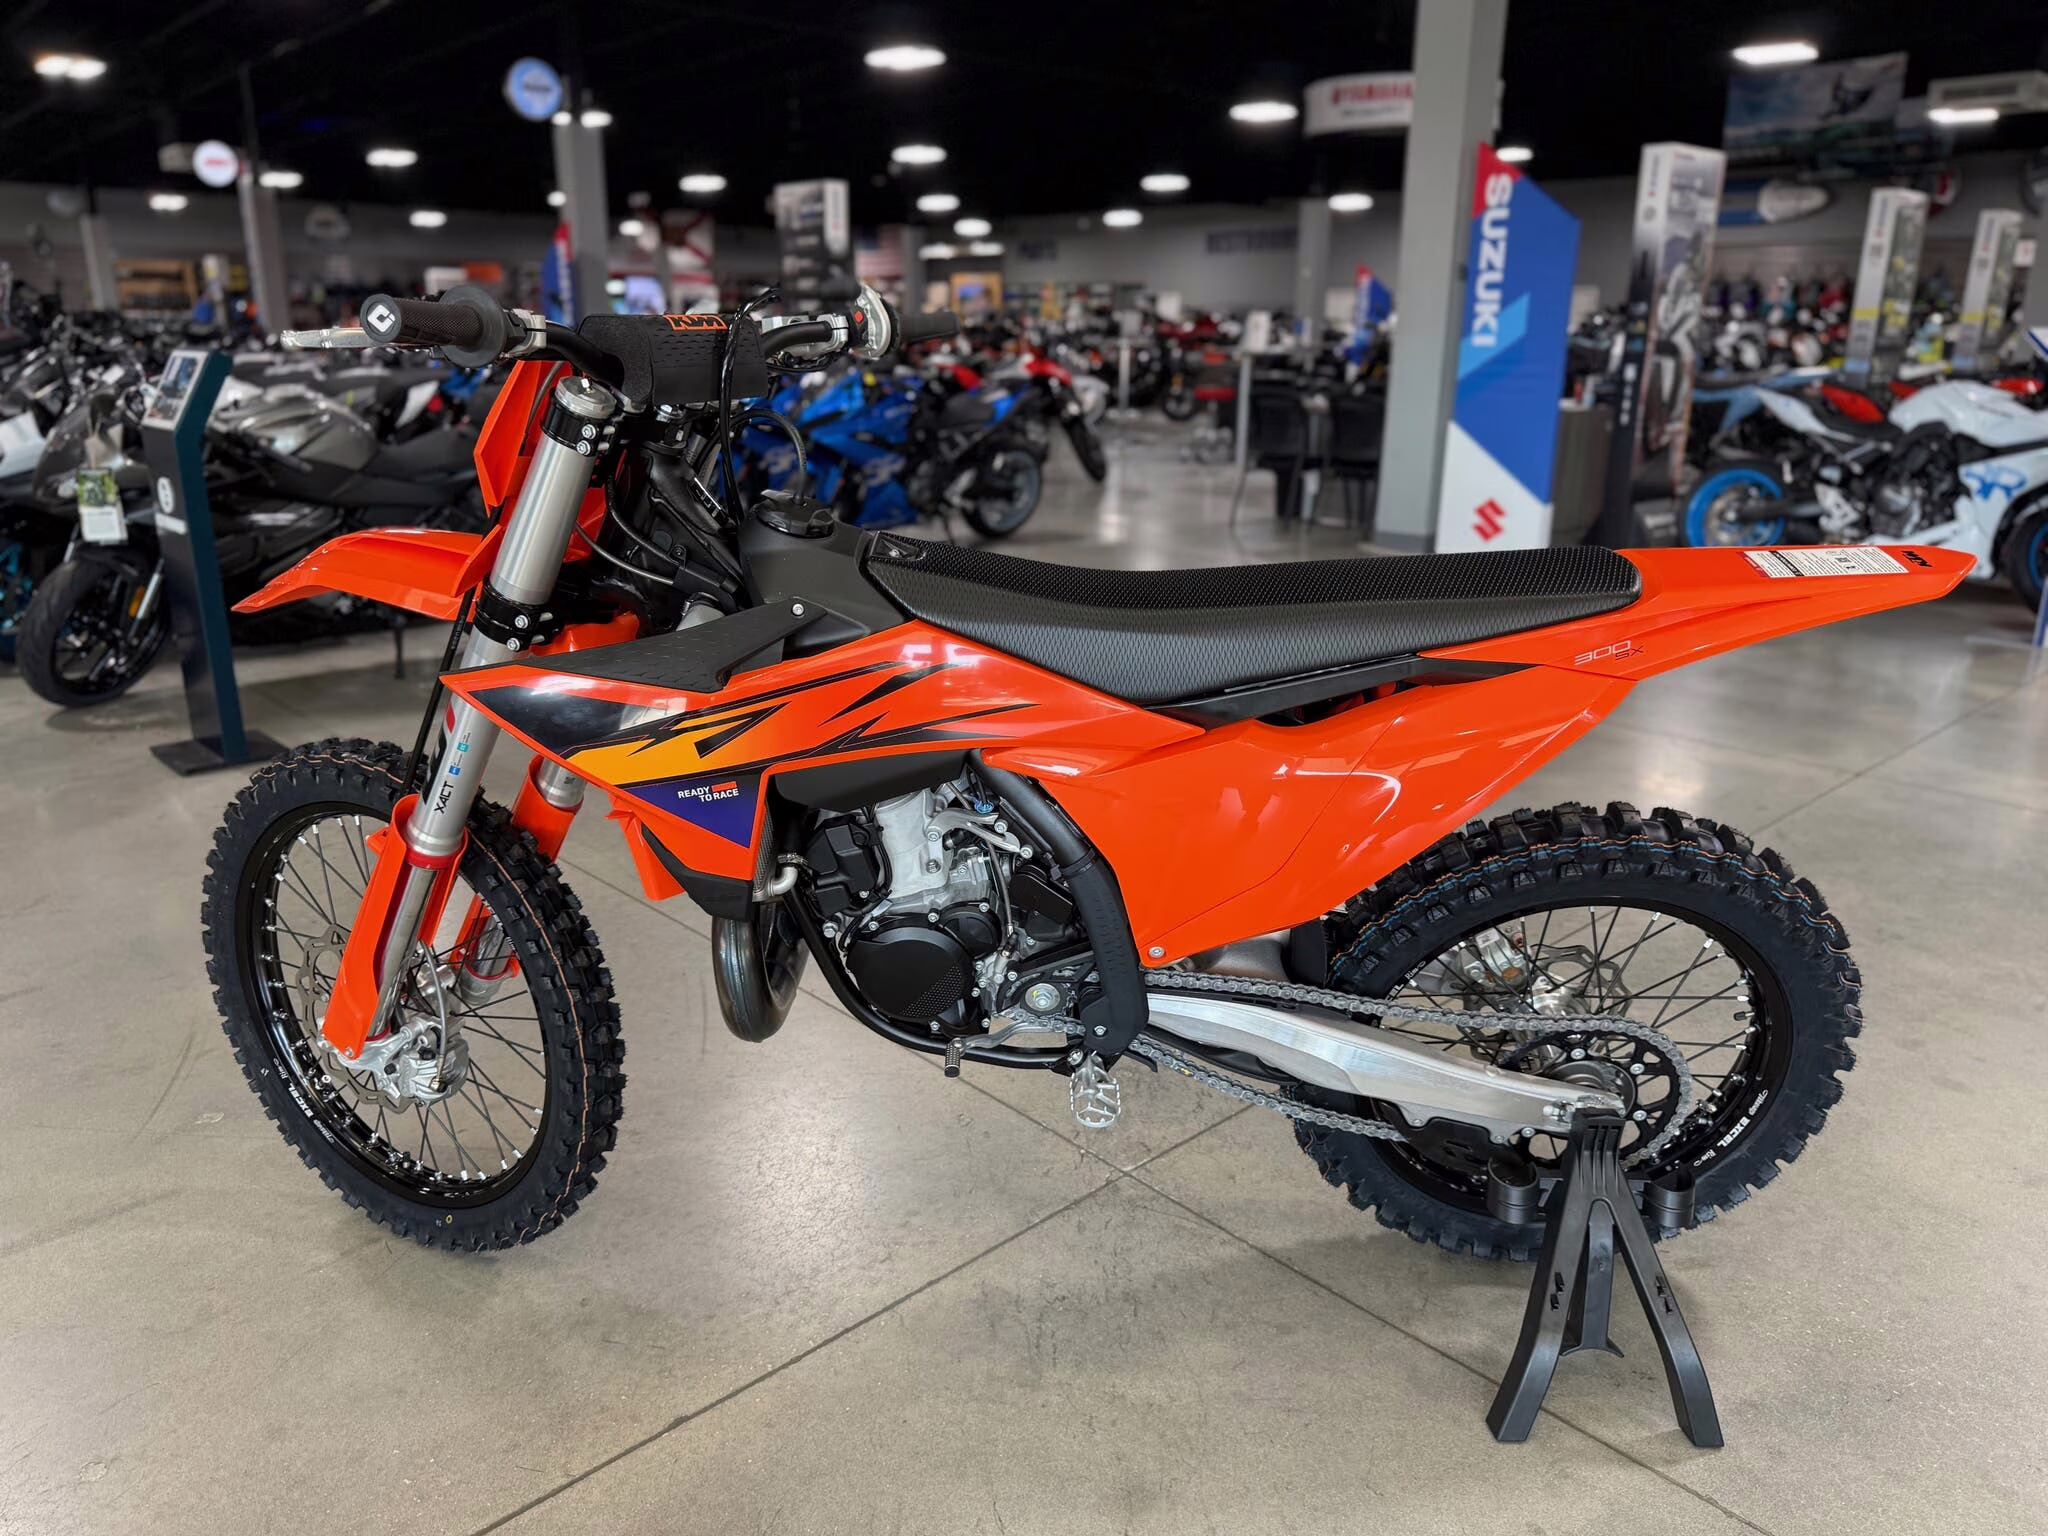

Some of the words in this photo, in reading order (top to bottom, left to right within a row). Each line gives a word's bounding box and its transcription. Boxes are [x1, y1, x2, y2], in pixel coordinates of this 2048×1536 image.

[1472, 173, 1513, 347] SUZUKI
[662, 314, 728, 331] KTM
[1574, 640, 1632, 666] 300
[1615, 645, 1644, 661] SX
[434, 780, 455, 815] XACT
[677, 785, 710, 799] READY
[699, 793, 713, 803] TO
[713, 788, 740, 801] RACE
[288, 1082, 314, 1119] EXCEL
[1716, 1116, 1751, 1148] EXCEL
